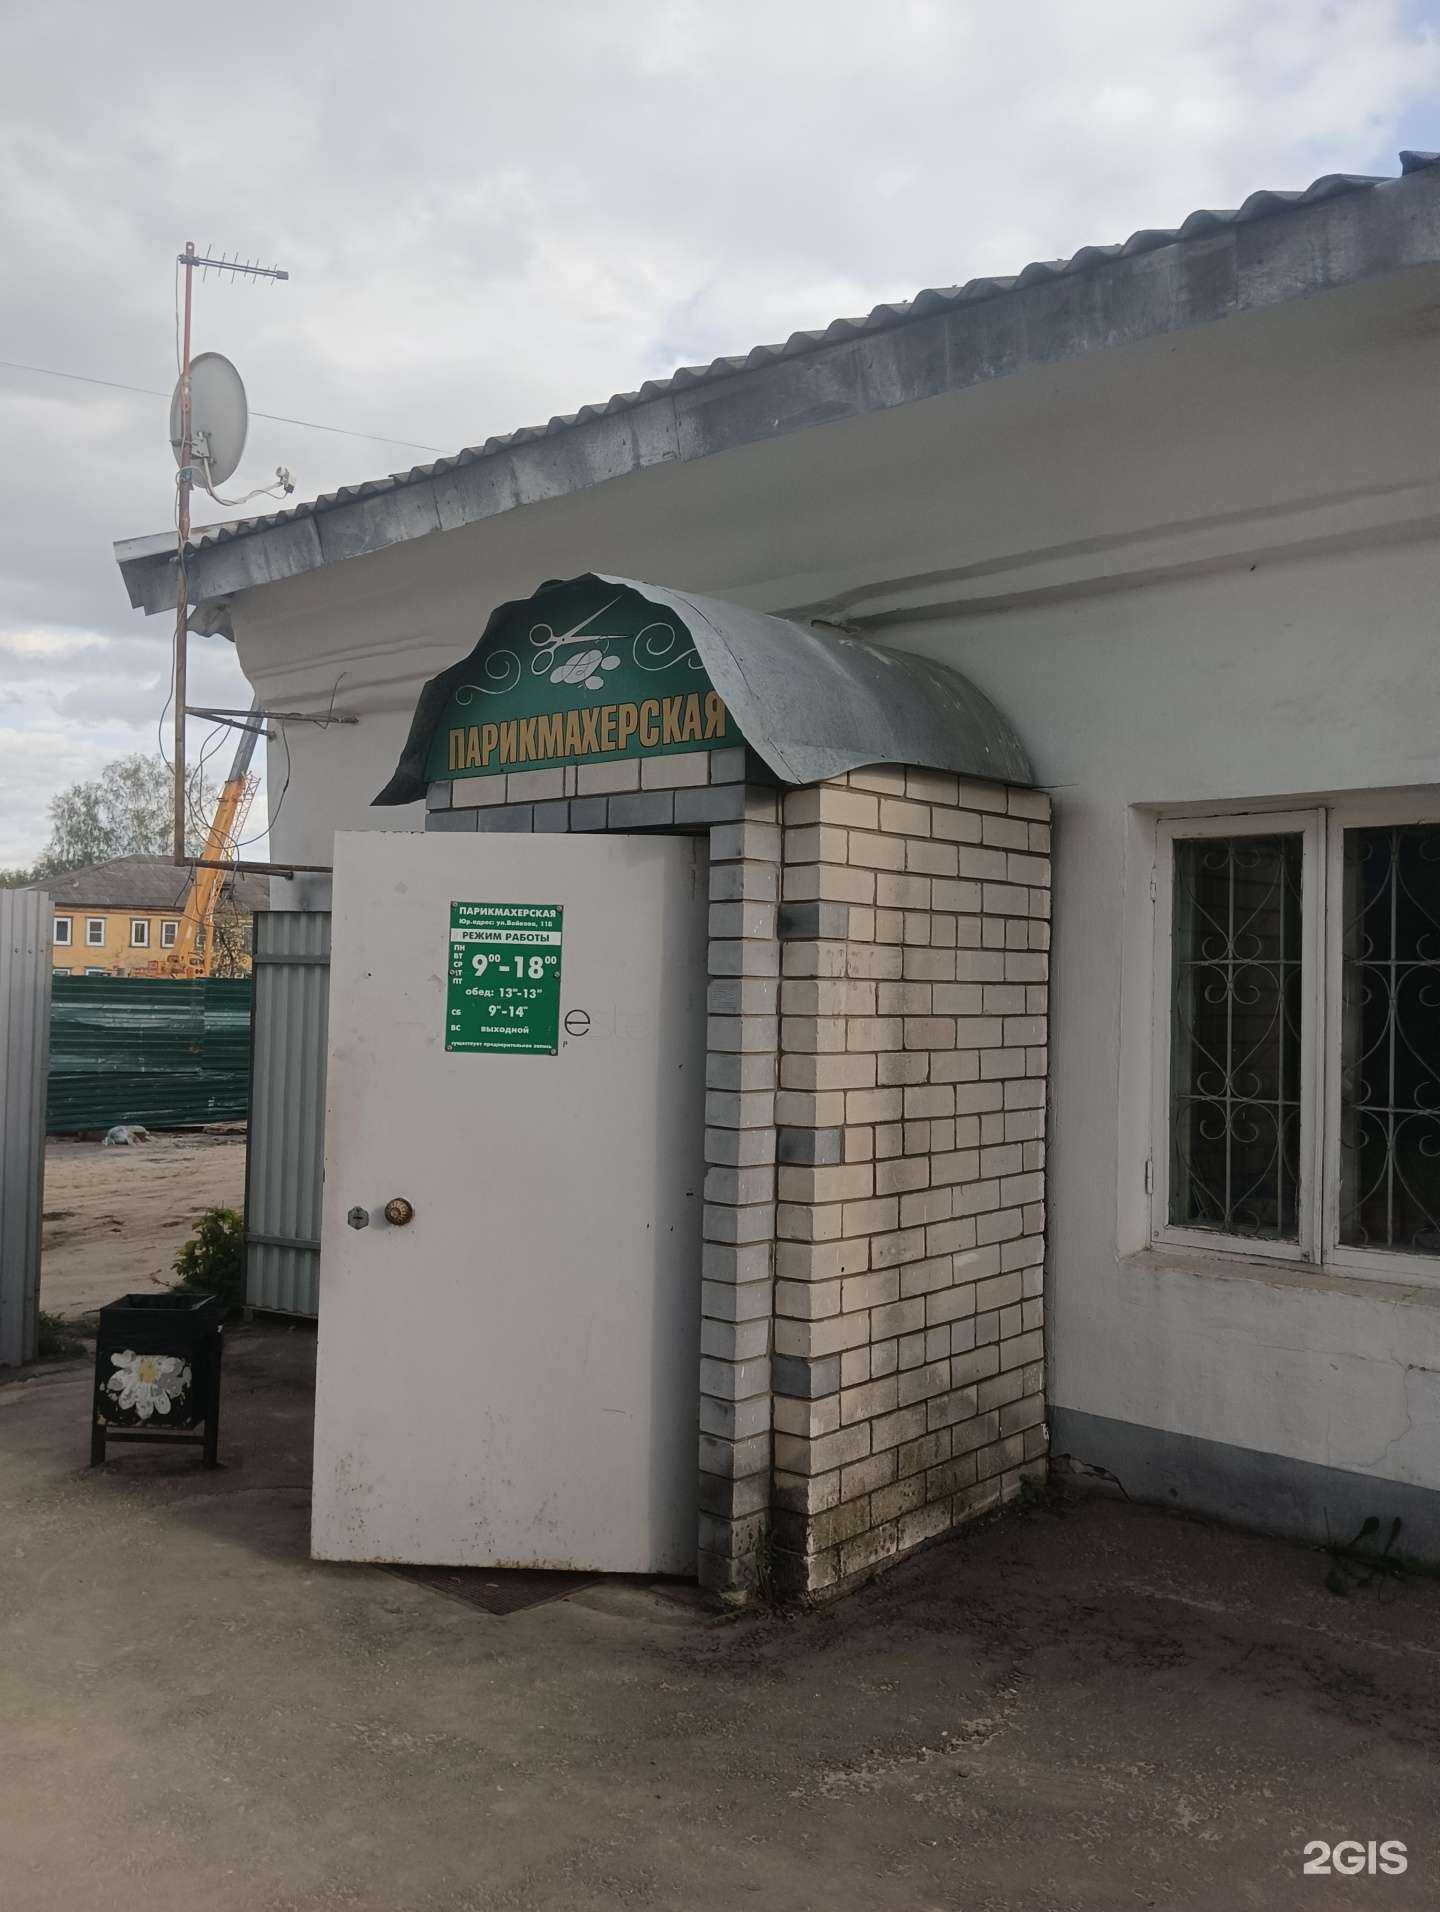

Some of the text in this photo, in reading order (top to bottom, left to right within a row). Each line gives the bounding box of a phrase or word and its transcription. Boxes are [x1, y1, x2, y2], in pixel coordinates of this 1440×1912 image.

[448, 690, 727, 771] ПАРИКМАХЕРСКАЯ
[459, 907, 557, 918] ПАРИКМАХЕРСКАЯ
[462, 931, 550, 942] РЕЖИМ РАБОТЫ
[453, 944, 466, 952] ПН
[465, 987, 495, 997] обед:
[480, 1024, 530, 1034] выходной
